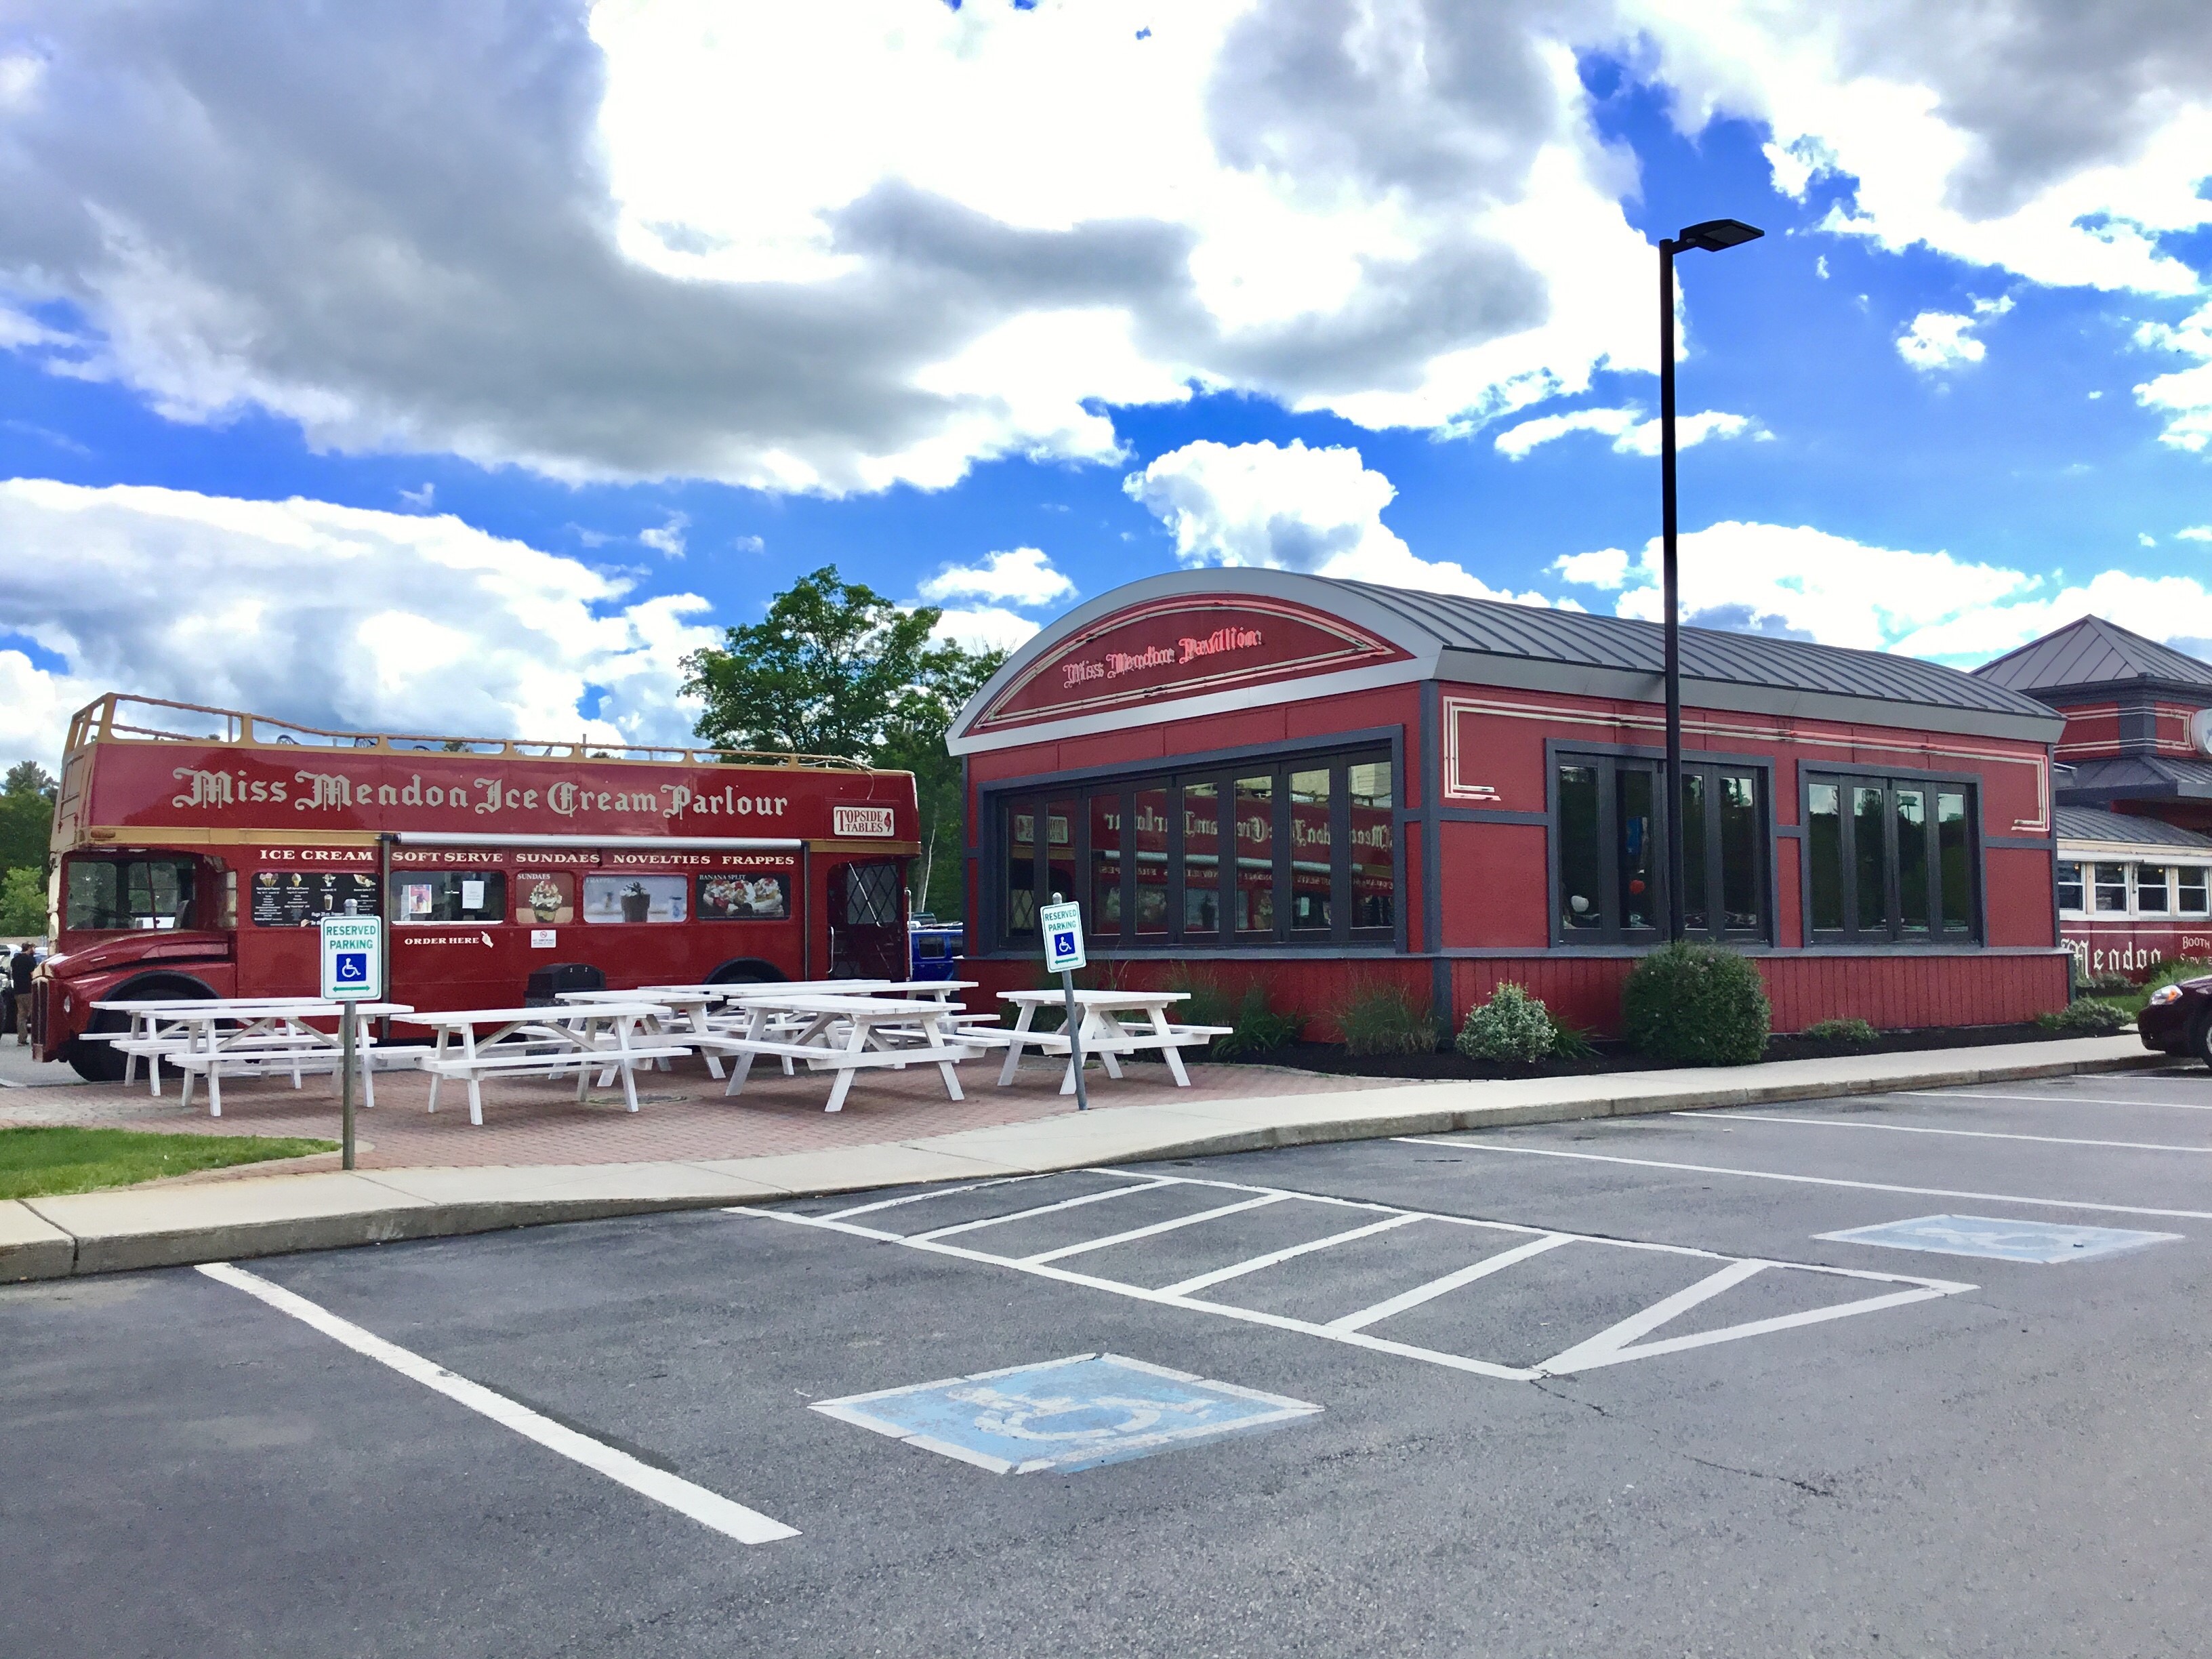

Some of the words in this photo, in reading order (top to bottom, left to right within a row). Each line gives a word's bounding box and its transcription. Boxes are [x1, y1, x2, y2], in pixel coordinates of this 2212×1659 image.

[1062, 660, 1104, 689] Miss
[1106, 646, 1175, 678] Mendon
[172, 766, 288, 809] Miss
[295, 770, 469, 811] Mendon
[474, 777, 539, 815] Ice
[547, 781, 658, 817] Cream
[660, 784, 787, 820] Parlour
[836, 810, 883, 832] TOPSIDE
[846, 822, 884, 832] TABLES
[260, 850, 295, 860] ICE
[301, 851, 374, 861] CREAM
[391, 852, 441, 862] SOFT
[444, 853, 504, 863] SERVE
[515, 853, 600, 863] SUNDAES
[613, 855, 711, 864] NOVELTIES
[722, 855, 795, 865] FRAPPES
[1044, 909, 1077, 921] RESERVED
[326, 925, 376, 935] RESERVED
[1048, 920, 1077, 932] PARKING
[330, 939, 373, 949] PARKING
[2183, 936, 2211, 950] BOOTH
